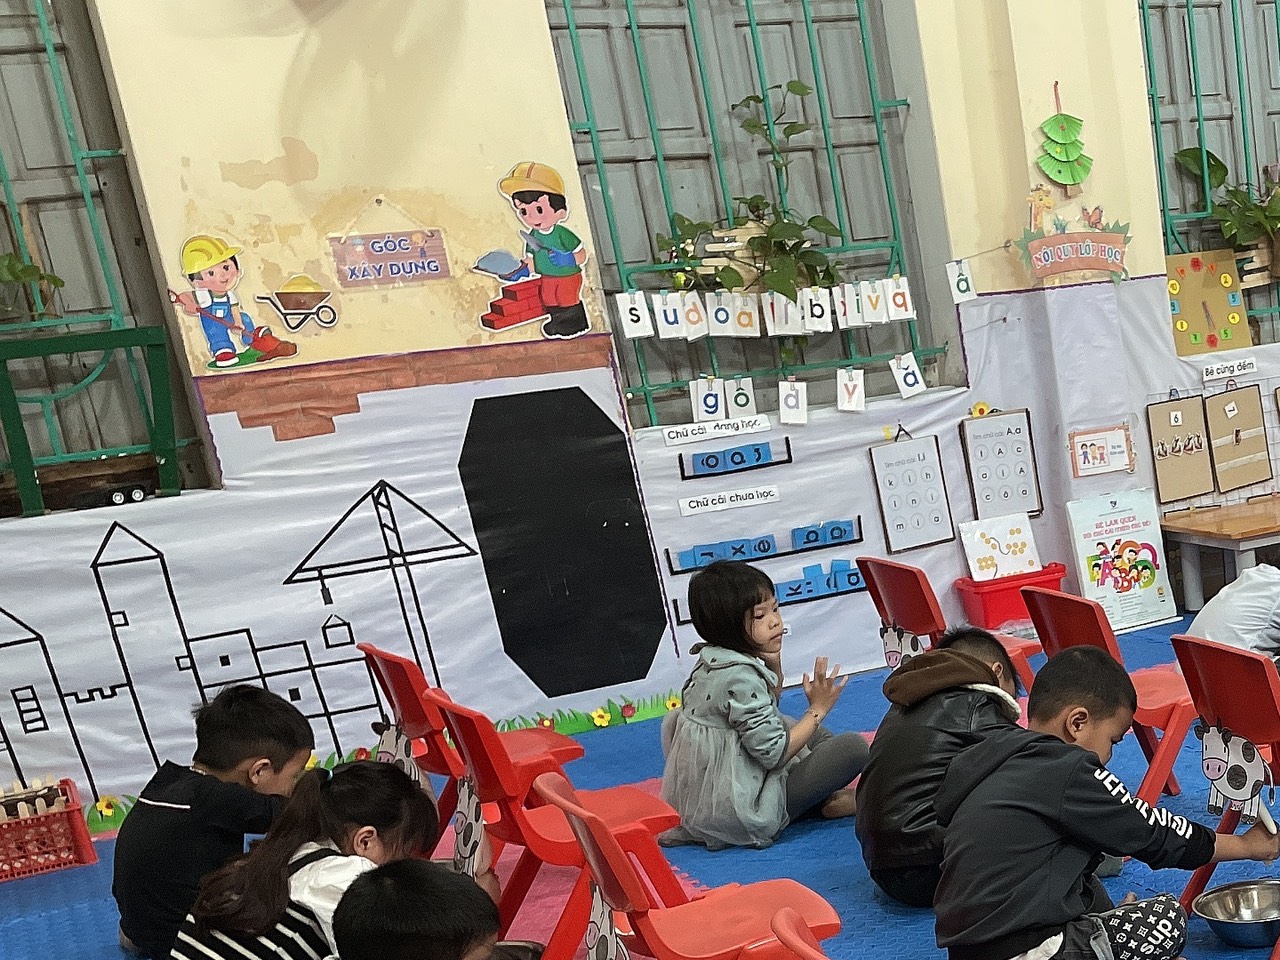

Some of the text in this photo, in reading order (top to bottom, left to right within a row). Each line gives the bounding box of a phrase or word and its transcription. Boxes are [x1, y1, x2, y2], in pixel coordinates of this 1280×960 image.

[370, 235, 411, 254] GÓC
[347, 261, 385, 281] XÂY
[956, 272, 971, 293] â
[628, 306, 641, 324] s
[663, 307, 679, 325] u
[714, 307, 729, 324] o
[736, 310, 753, 328] a
[809, 298, 825, 319] b
[867, 293, 881, 311] v
[892, 291, 909, 312] q
[703, 392, 719, 414] g
[733, 387, 750, 408] ô
[843, 382, 858, 404] y
[902, 365, 920, 388] ă
[888, 479, 894, 487] k
[925, 471, 931, 480] h
